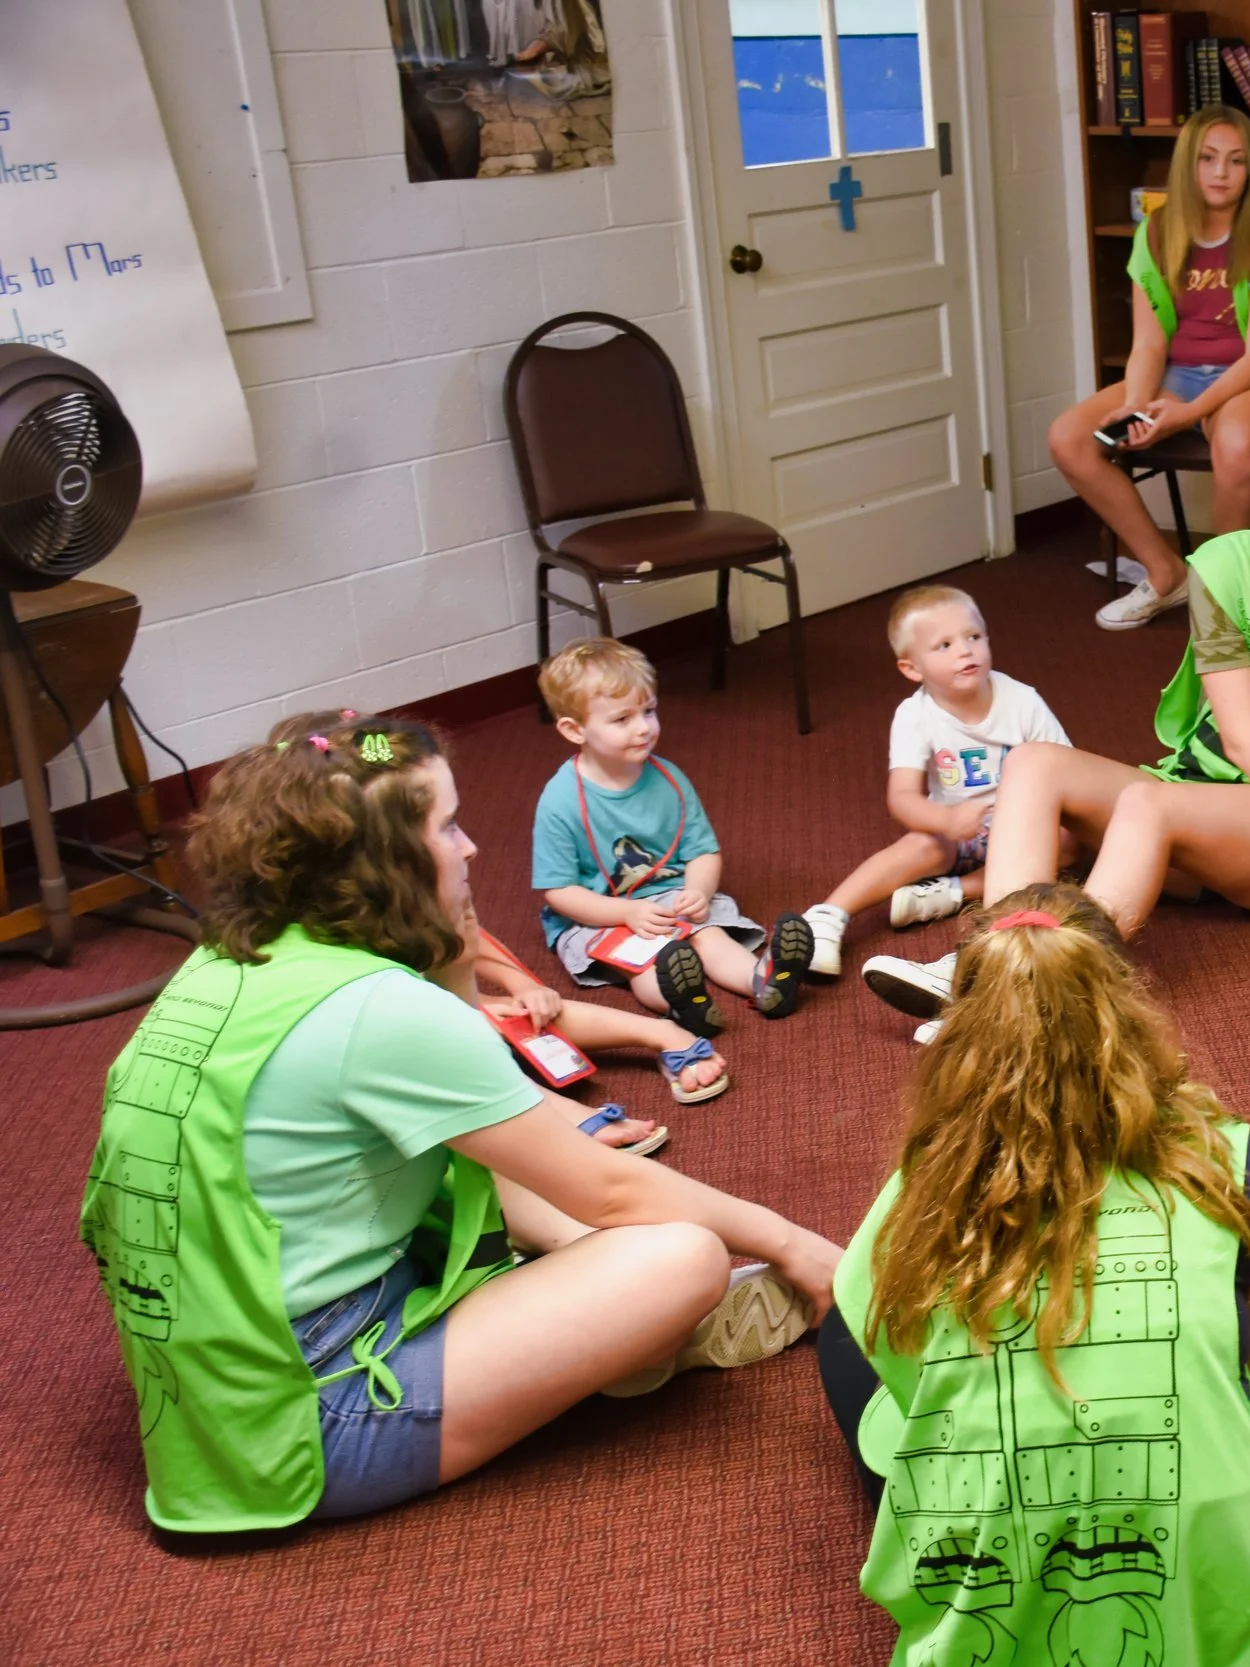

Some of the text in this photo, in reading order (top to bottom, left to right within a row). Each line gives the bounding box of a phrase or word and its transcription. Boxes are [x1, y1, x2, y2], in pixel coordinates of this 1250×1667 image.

[0, 145, 58, 185] kers
[30, 256, 55, 288] to
[65, 242, 143, 282] Mars
